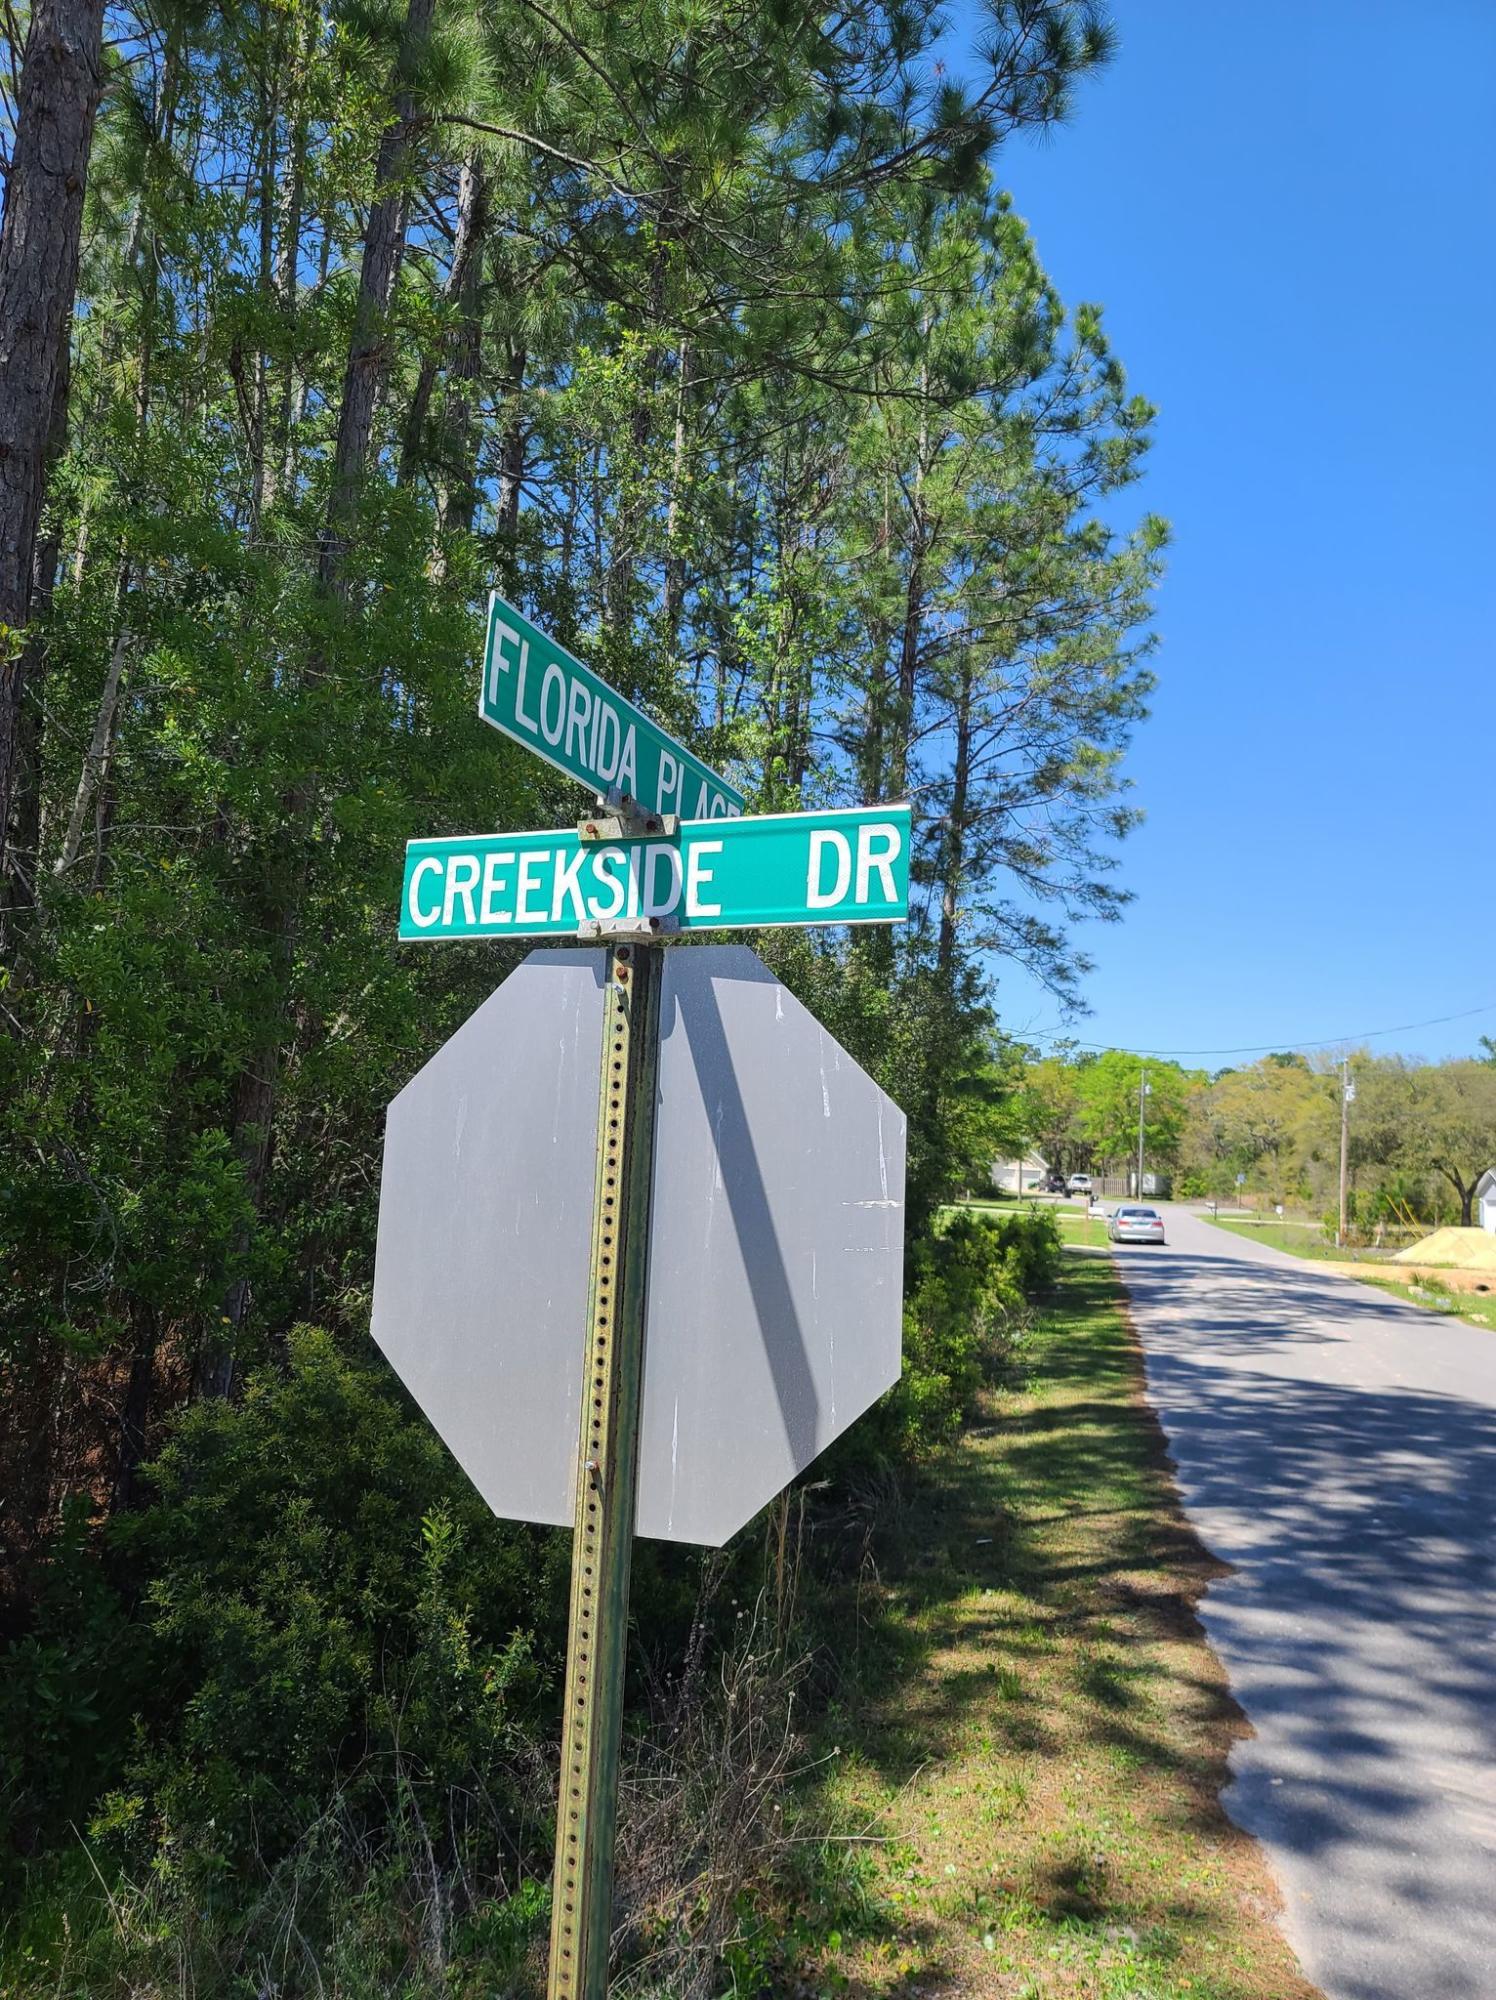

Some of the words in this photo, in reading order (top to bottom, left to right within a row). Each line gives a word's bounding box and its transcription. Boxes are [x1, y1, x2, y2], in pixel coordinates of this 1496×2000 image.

[488, 617, 638, 801] FLORIDA
[408, 841, 724, 928] CREEKSIDE
[806, 823, 902, 909] DR
